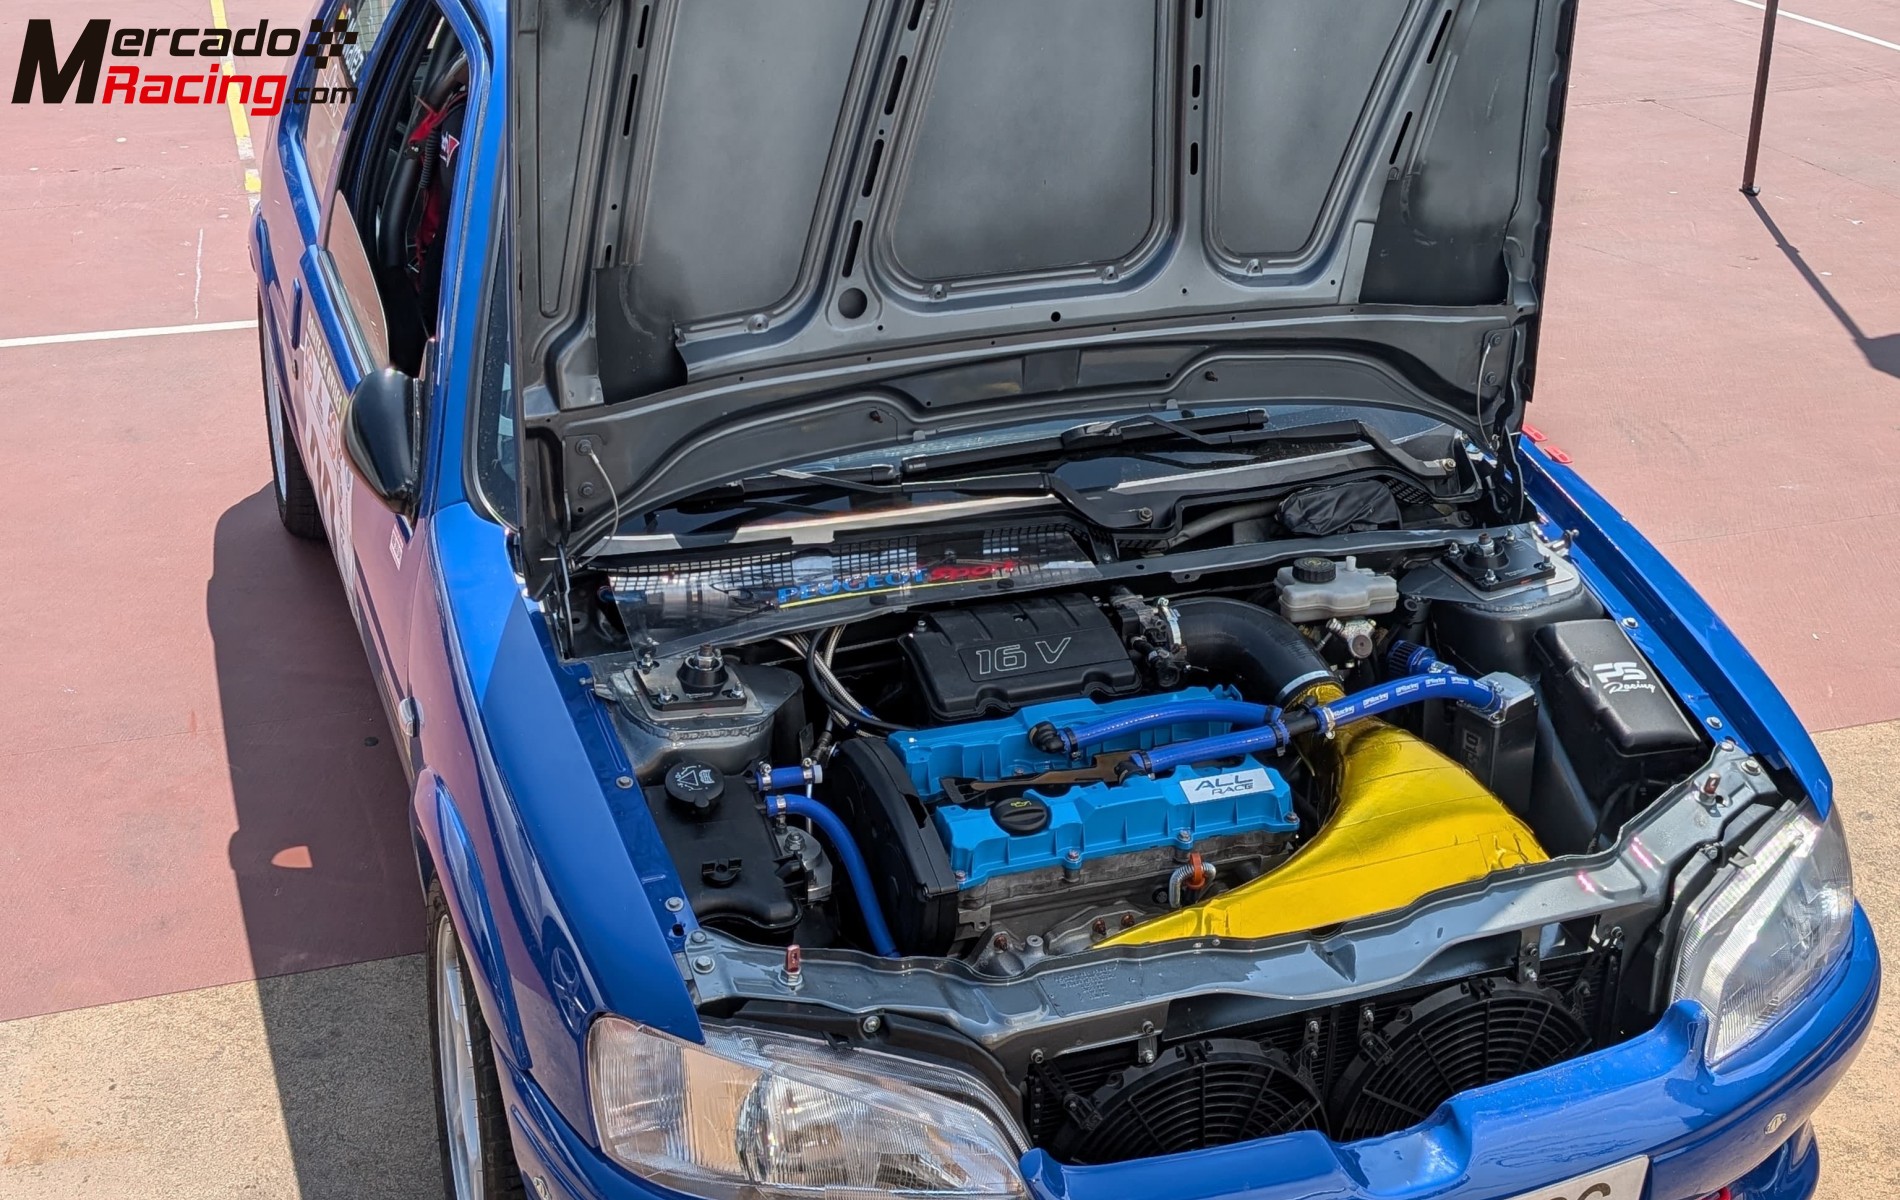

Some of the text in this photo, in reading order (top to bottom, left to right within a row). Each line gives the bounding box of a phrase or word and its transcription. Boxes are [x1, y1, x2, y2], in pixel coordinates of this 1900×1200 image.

[777, 567, 929, 603] PEUGEOT
[976, 637, 1072, 675] 16 V
[1603, 681, 1656, 694] Racing
[1195, 775, 1253, 791] ALL
[1211, 782, 1254, 795] RACE
